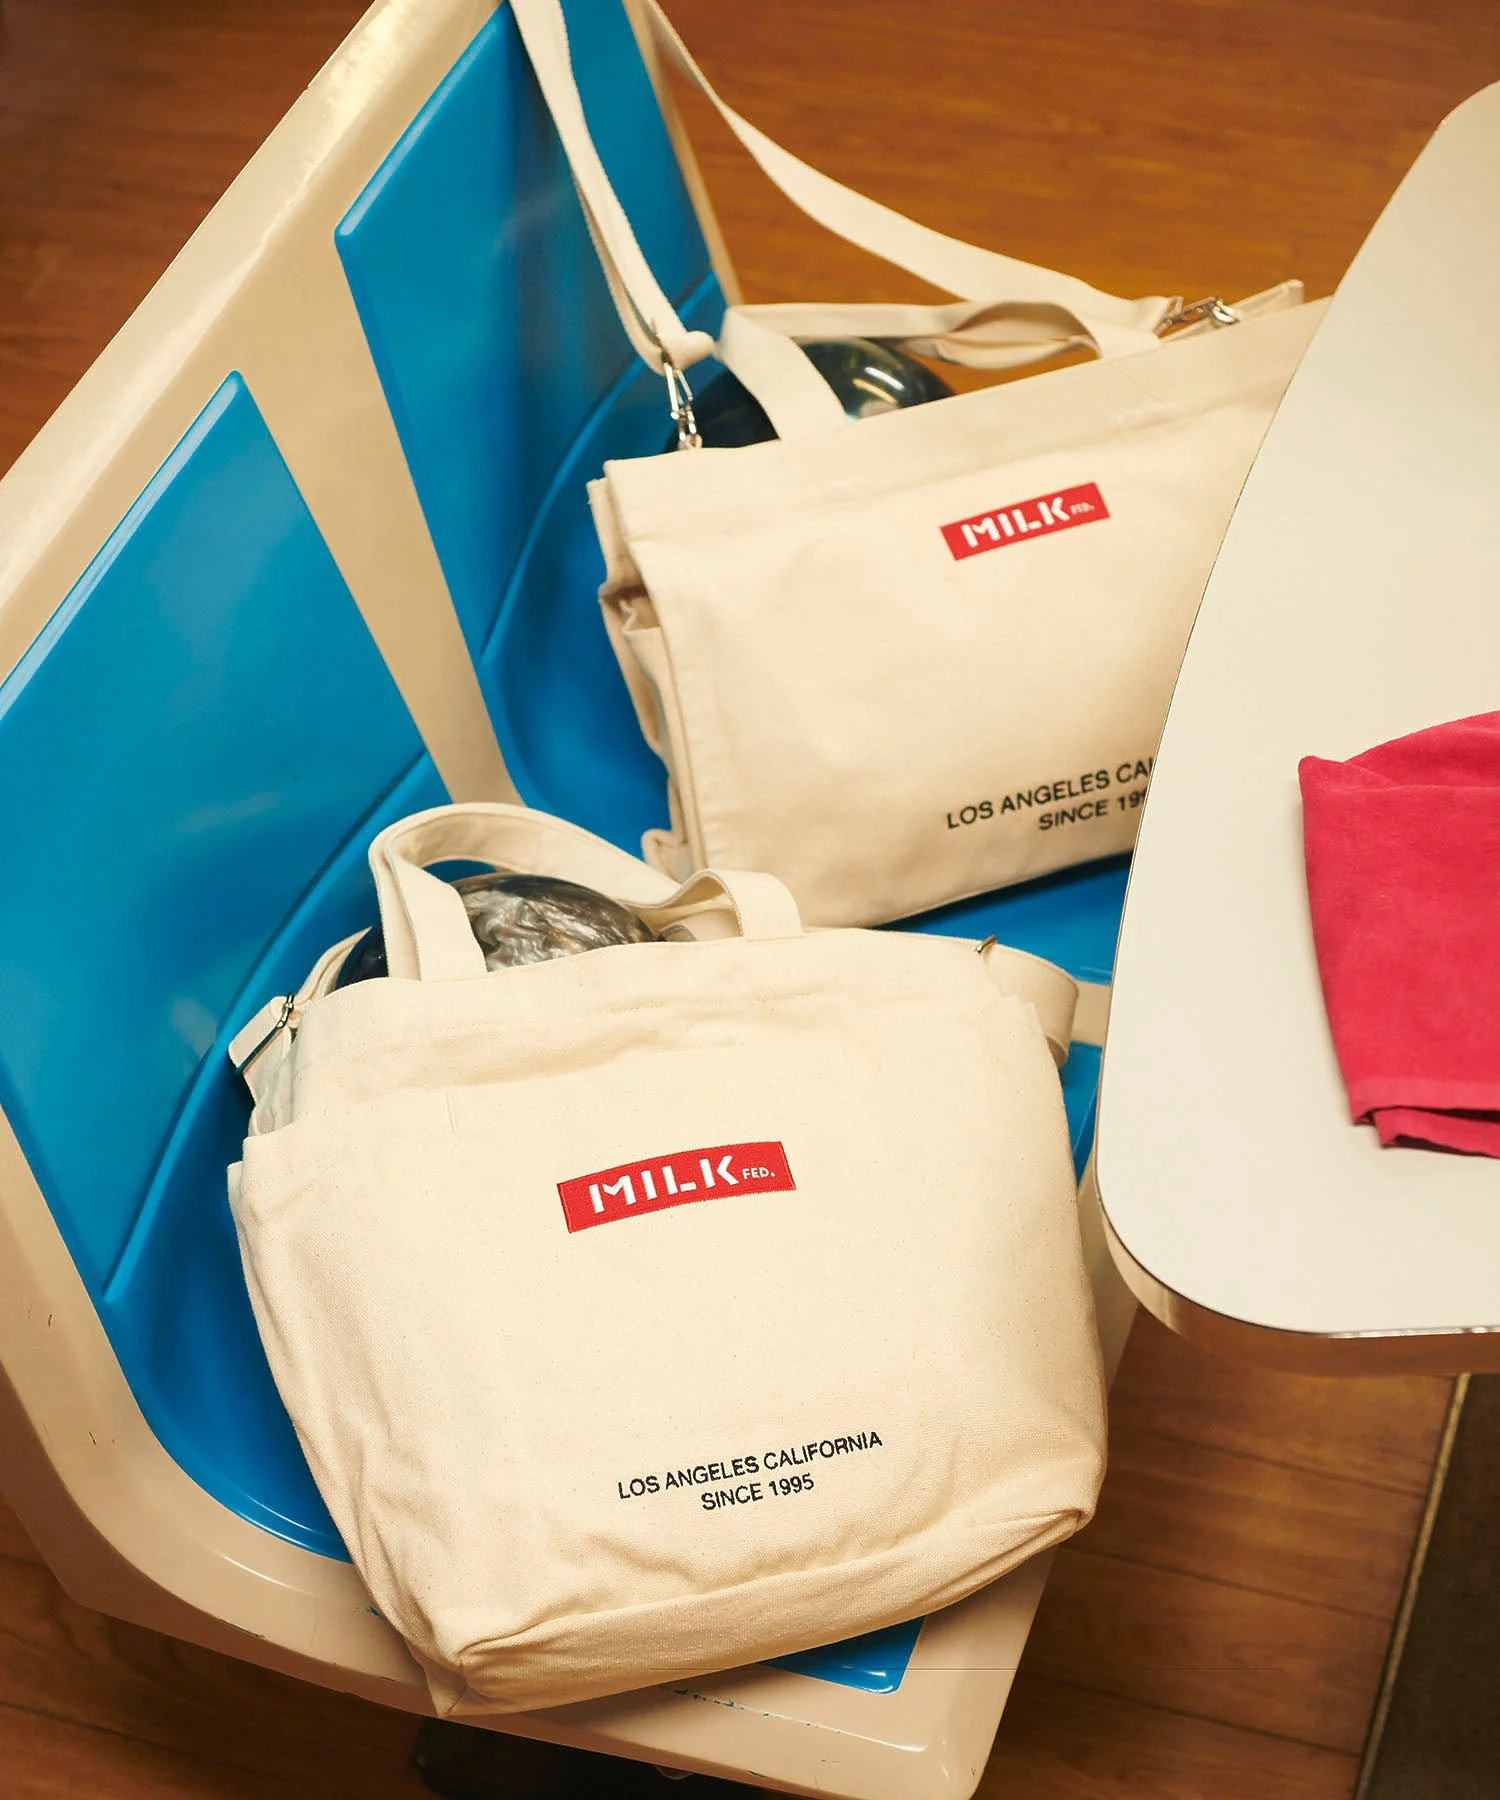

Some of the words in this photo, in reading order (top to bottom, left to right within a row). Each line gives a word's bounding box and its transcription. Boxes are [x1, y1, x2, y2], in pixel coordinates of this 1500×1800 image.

[961, 497, 1070, 548] MILK
[947, 800, 994, 829] LOS
[1000, 769, 1110, 814] ANGELES
[1039, 798, 1108, 831] SINCE
[589, 1155, 740, 1214] MILK
[742, 1167, 776, 1180] FED.
[618, 1475, 661, 1500] LOS
[665, 1455, 760, 1490] ANGELES
[763, 1431, 883, 1470] CALIFORNIA
[701, 1483, 764, 1511] SINCE
[769, 1473, 815, 1496] 1995
